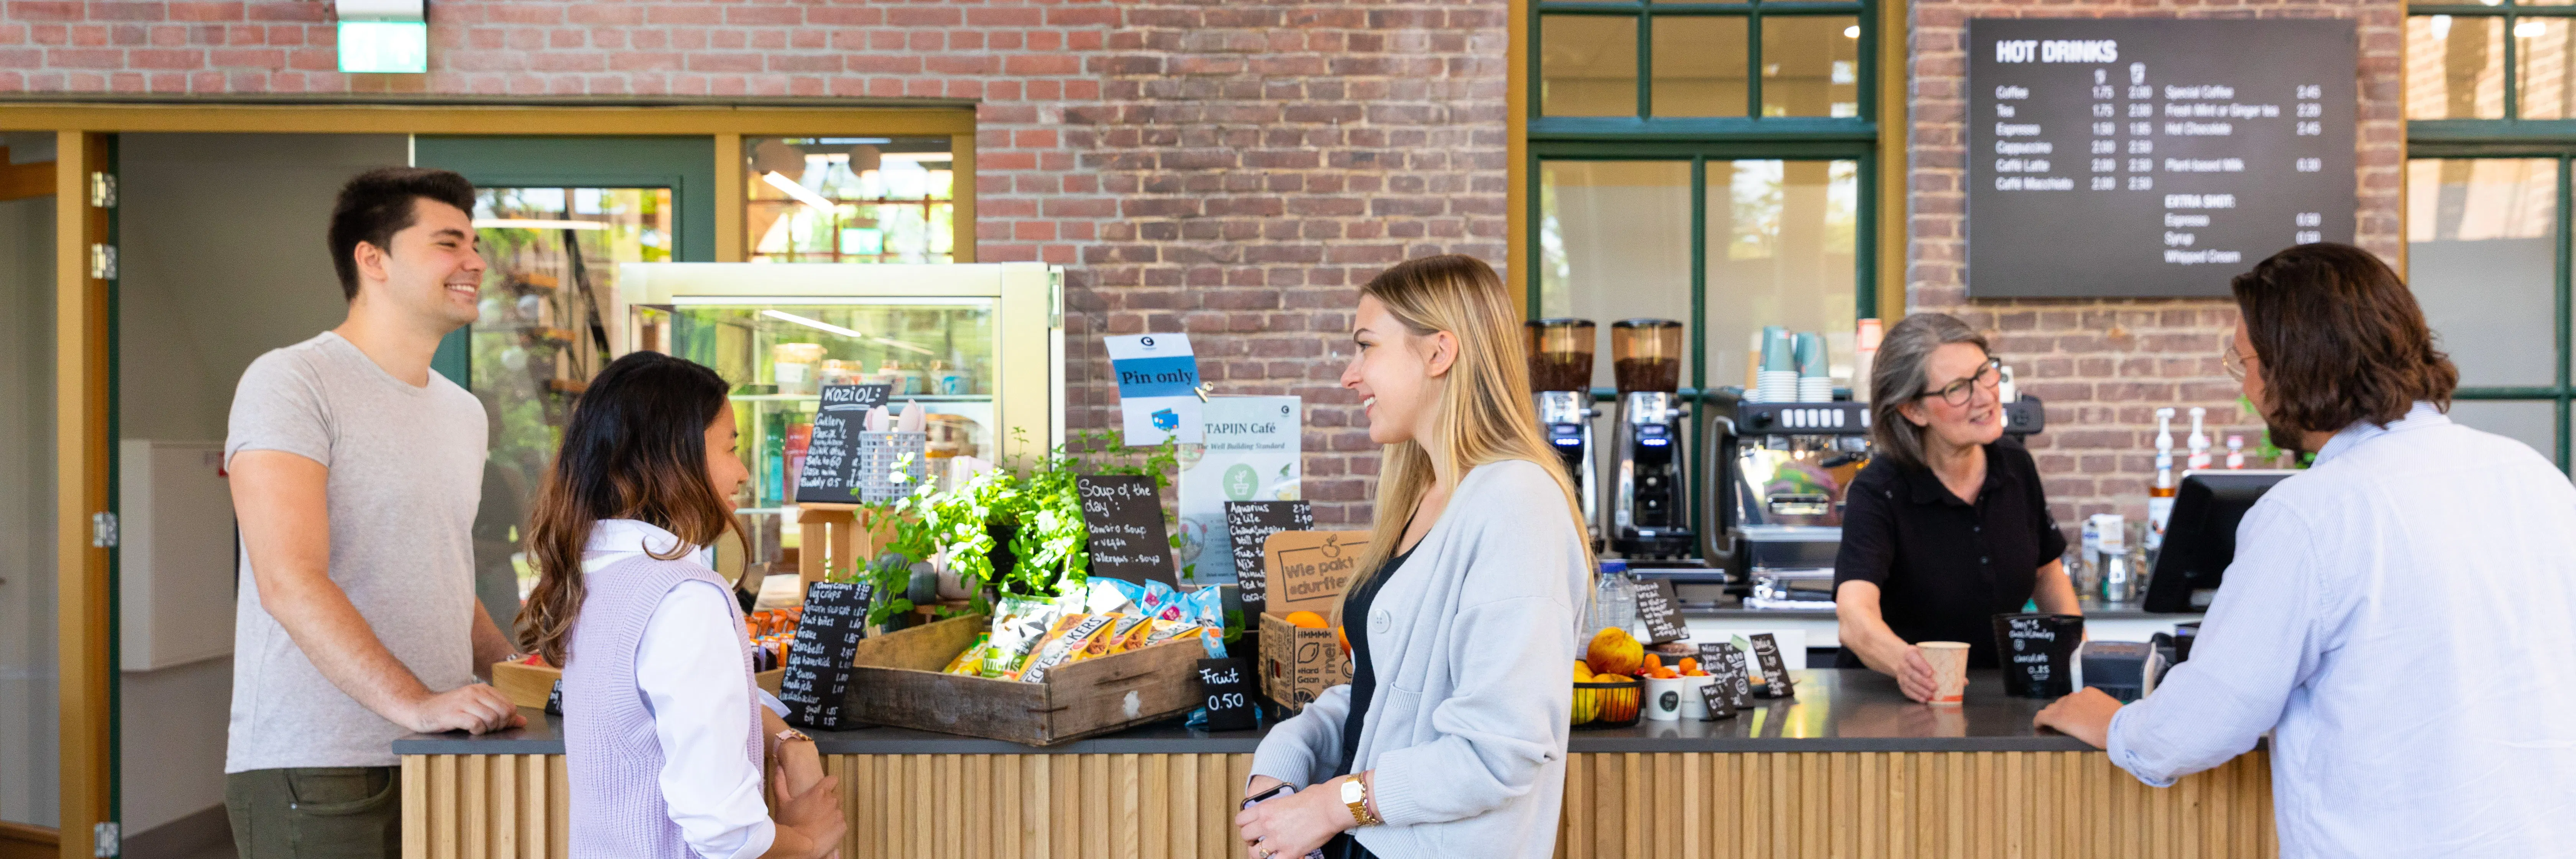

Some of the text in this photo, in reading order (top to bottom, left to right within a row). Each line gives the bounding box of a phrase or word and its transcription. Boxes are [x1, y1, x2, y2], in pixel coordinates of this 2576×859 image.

[1997, 41, 2117, 62] HOT DRINKS
[1997, 86, 2152, 98] Coffee 1.75 2.00
[2166, 86, 2320, 100] Special Coffee 2.45
[1997, 105, 2152, 116] Tea 1.75 2.00
[2166, 104, 2191, 116] Fresh
[2195, 104, 2216, 116] Mint
[2218, 106, 2228, 116] or
[2231, 104, 2260, 118] Ginger
[2263, 104, 2279, 116] tea
[1997, 123, 2040, 136] Espresso
[2093, 123, 2114, 134] 1.50
[2166, 122, 2320, 134] Hot Chocolate 2.45
[1997, 141, 2152, 154] Cappuccino 2.00 2.50
[2024, 159, 2049, 171] Latte
[2093, 159, 2115, 171] 2.00
[2129, 159, 2152, 171] 2.50
[2166, 159, 2221, 171] Plant-based
[2224, 159, 2244, 171] Milk
[2024, 178, 2073, 189] Macchiato
[2093, 178, 2115, 189] 2.00
[2129, 178, 2152, 189] 2.50
[2166, 195, 2234, 207] EXTRA SHOT:
[2166, 214, 2320, 227] Espresso 0.50
[2165, 232, 2193, 245] Syrup
[2165, 250, 2240, 264] Whipped Cream
[1122, 368, 1193, 385] Pin only
[1205, 422, 1276, 435] TAPIJN Café
[1227, 442, 1254, 451] Building
[1255, 441, 1285, 449] Standard
[1079, 479, 1152, 501] Soup of the
[1085, 499, 1110, 517] day
[1230, 502, 1269, 516] Aquarius
[1089, 521, 1147, 539] tomato soup
[1101, 538, 1127, 551] vegan
[1285, 556, 1354, 578] Wie pakt
[1289, 576, 1348, 595] #durfte
[1199, 668, 1239, 685] Fruit
[1297, 676, 1319, 684] Gaan
[1208, 693, 1244, 711] 0.50
